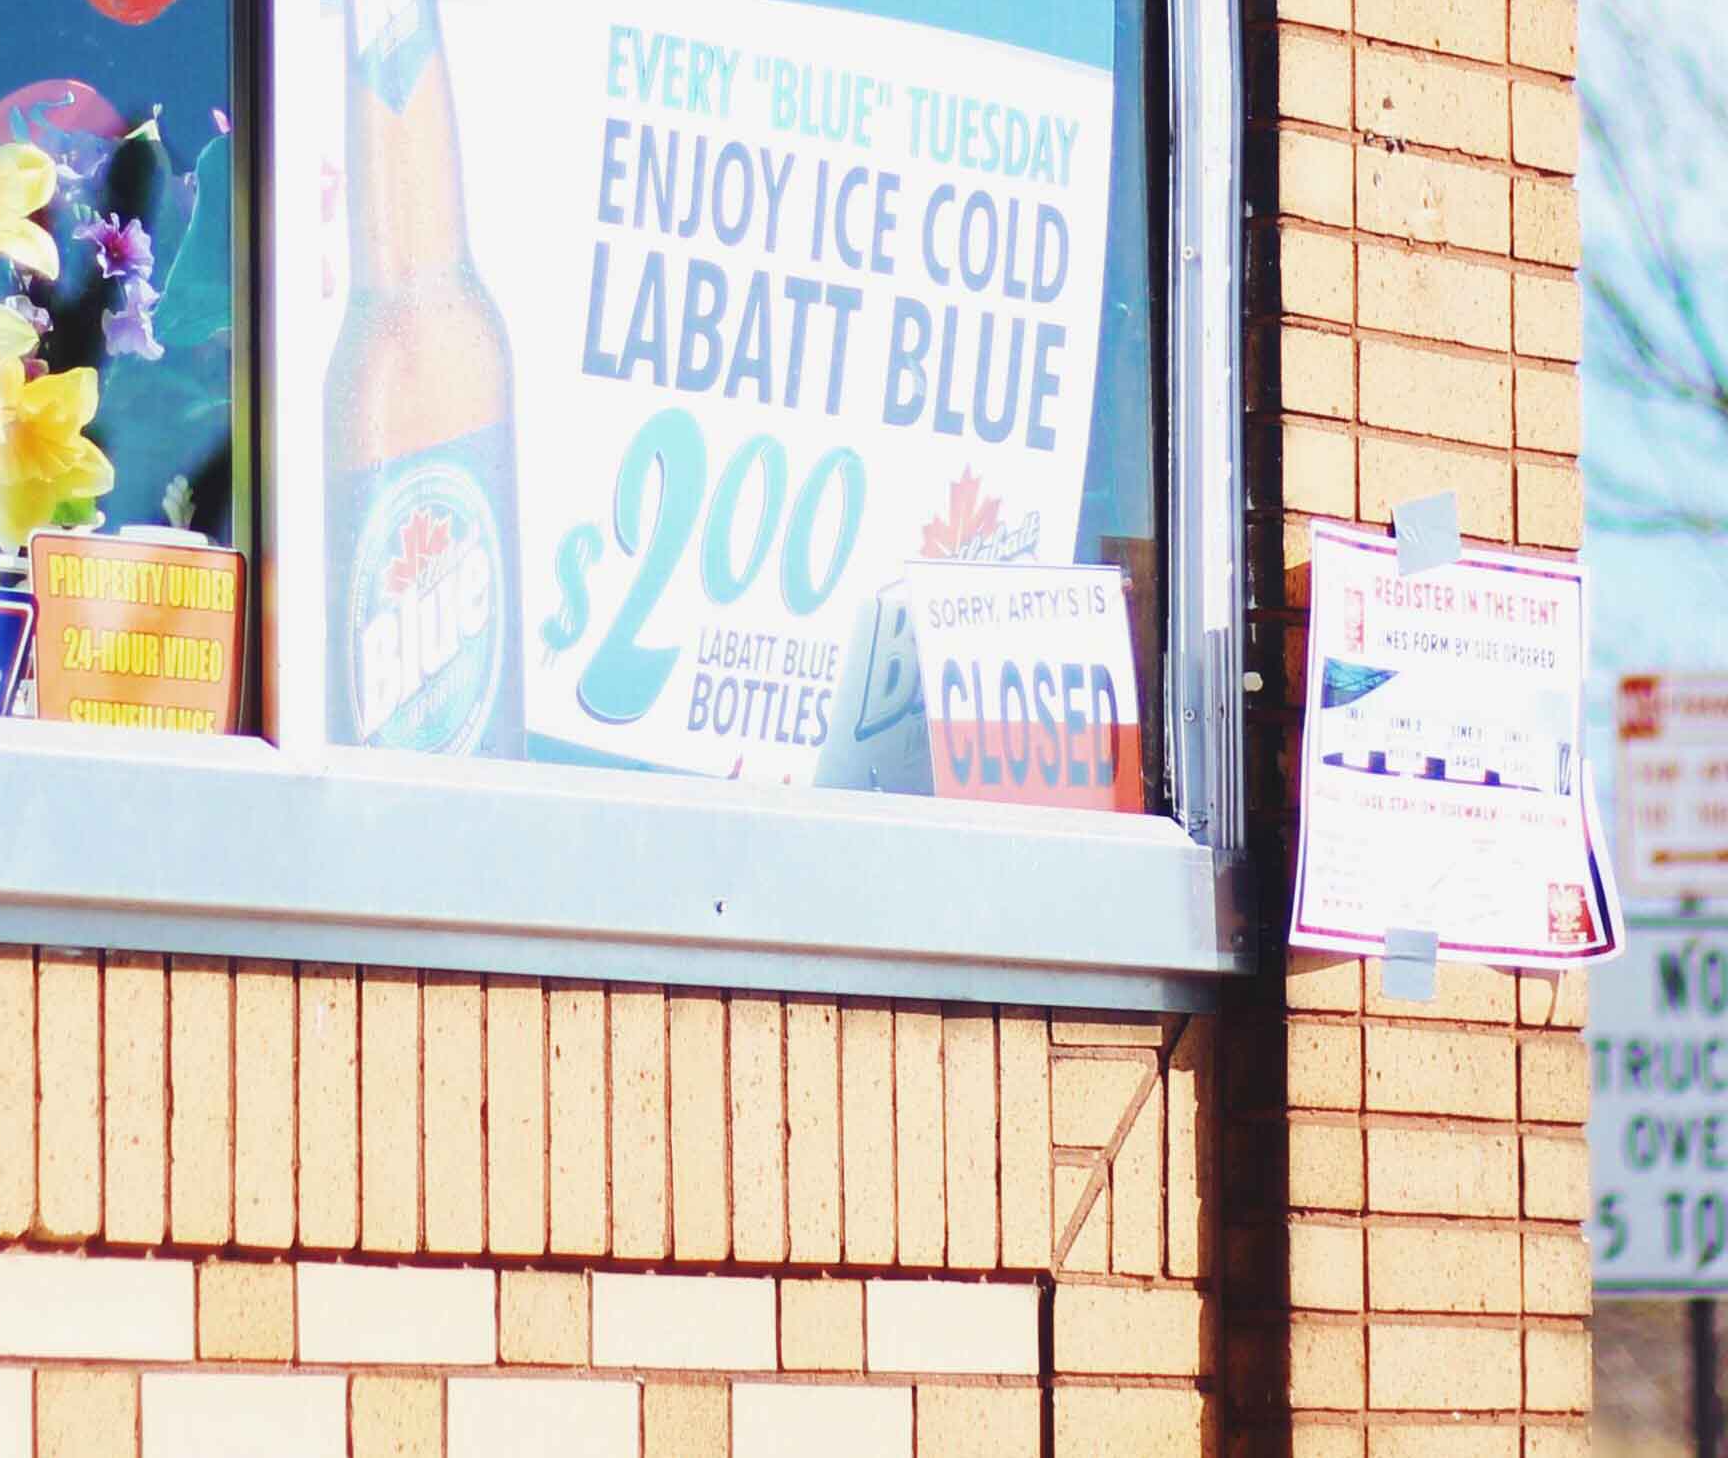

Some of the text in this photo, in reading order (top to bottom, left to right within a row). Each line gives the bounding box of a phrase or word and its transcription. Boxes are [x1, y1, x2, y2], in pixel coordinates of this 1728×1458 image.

[605, 21, 1080, 189] EVERY "BLUE" TUESDAY
[597, 116, 1071, 305] ENJOY ICE COLD
[580, 239, 1068, 454] LABATT BLUE
[47, 552, 236, 614] PROPERTY UNDER
[1087, 583, 1107, 615] IS
[1374, 576, 1561, 628] REGISTER IN THE TENT
[161, 634, 225, 685] VIDEO
[696, 623, 840, 682] LABATT BLUE
[1413, 633, 1450, 656] FORM
[686, 669, 834, 749] BOTTLES
[939, 653, 1122, 790] CLOSED
